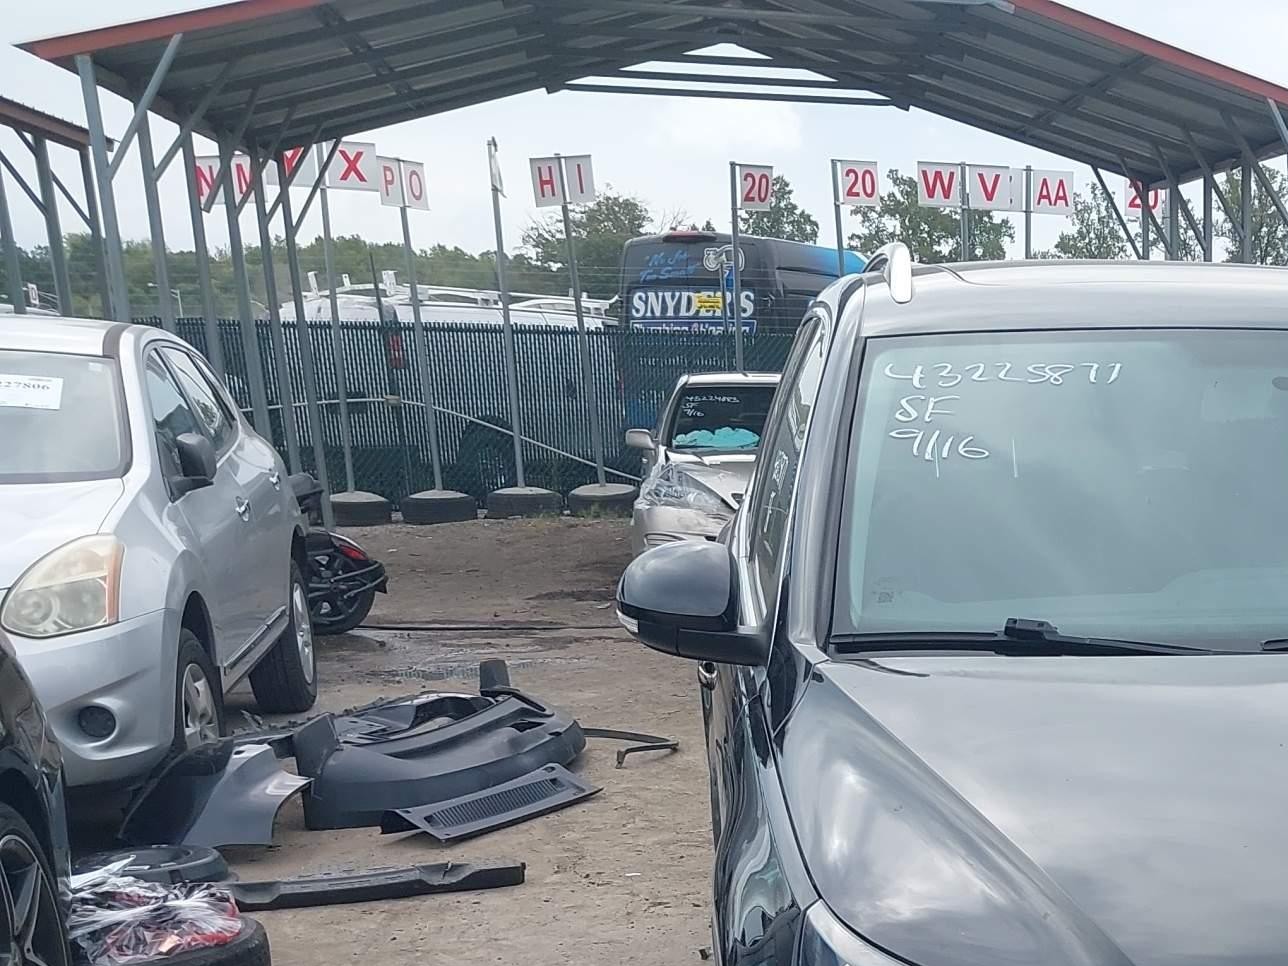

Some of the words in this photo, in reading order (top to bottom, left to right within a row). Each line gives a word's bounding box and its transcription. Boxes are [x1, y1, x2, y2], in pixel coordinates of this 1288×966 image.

[338, 150, 367, 182] X
[383, 166, 394, 196] P
[537, 165, 556, 198] H
[743, 172, 770, 203] 20
[845, 168, 876, 198] 20
[921, 170, 955, 200] W
[977, 172, 1001, 201] V
[1036, 178, 1069, 207] AA
[895, 396, 960, 422] SF
